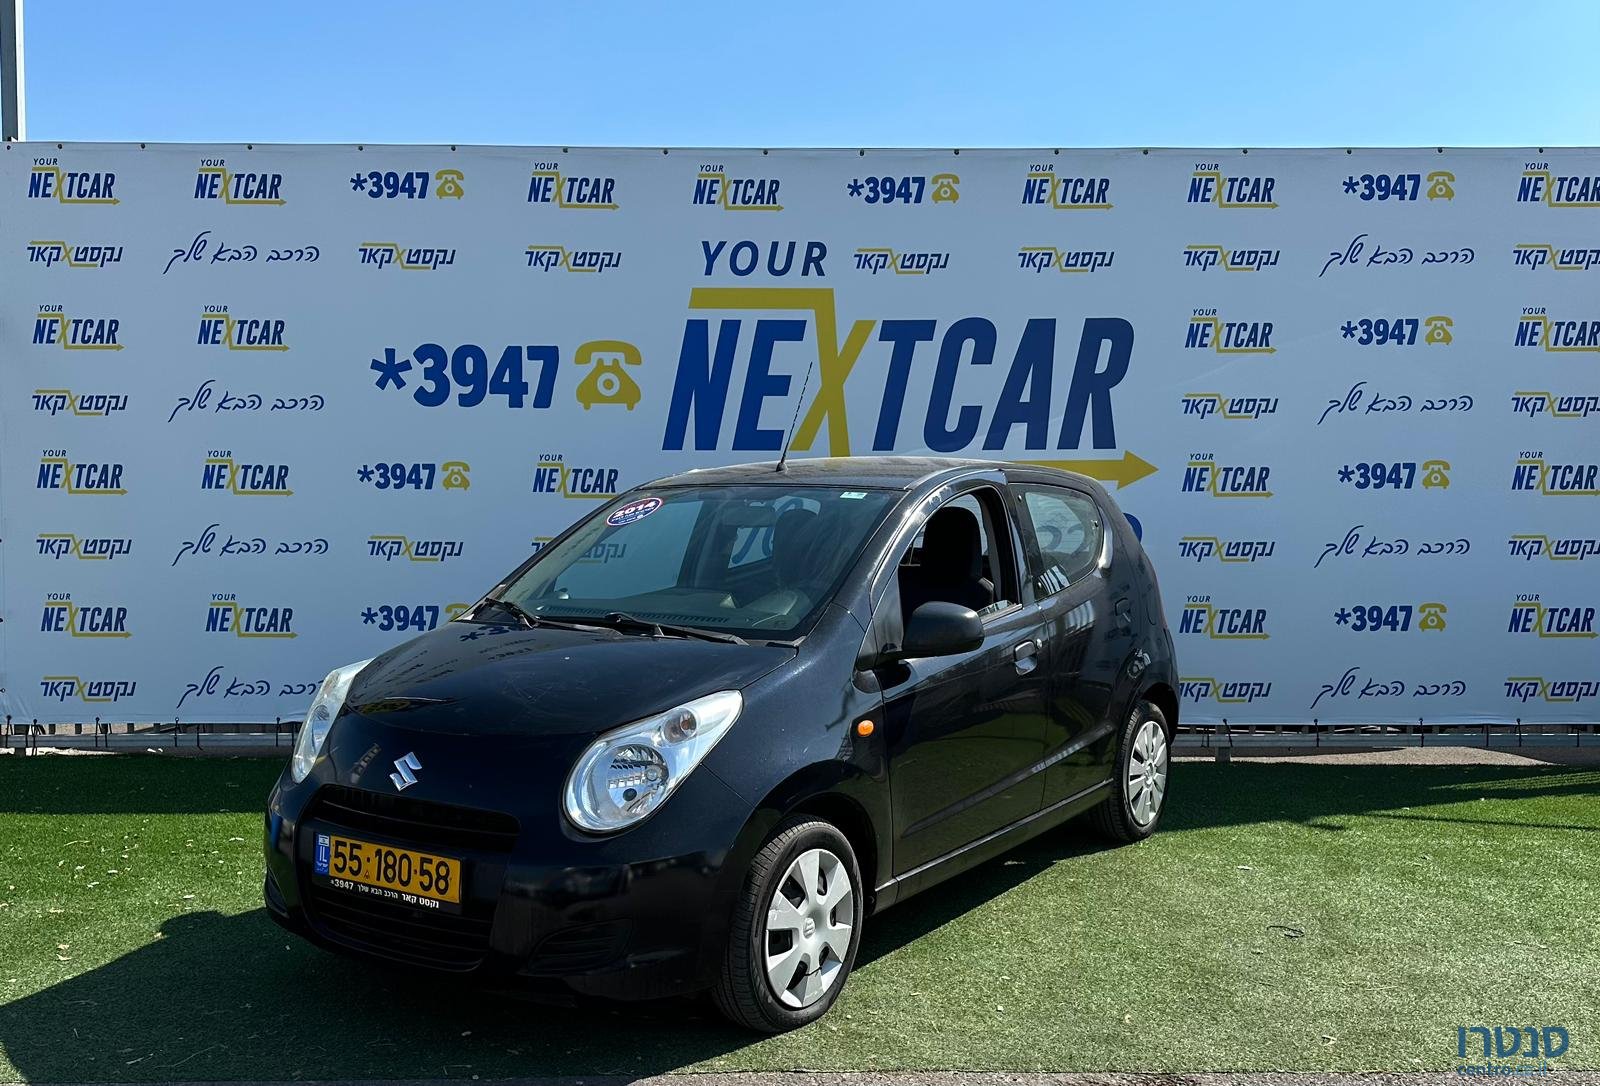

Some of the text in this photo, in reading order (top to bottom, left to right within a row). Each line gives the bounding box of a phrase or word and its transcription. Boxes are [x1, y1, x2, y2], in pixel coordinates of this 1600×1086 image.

[33, 157, 58, 166] YOUR
[200, 159, 225, 167] YOUR
[534, 162, 559, 171] YOUR
[699, 164, 724, 173] YOUR
[1029, 163, 1054, 172] YOUR
[1194, 163, 1219, 171] YOUR
[1524, 162, 1549, 171] YOUR
[28, 173, 115, 198] NEXTCAR
[194, 173, 282, 199] NEXTCAR
[528, 177, 615, 203] NEXTCAR
[693, 179, 780, 205] NEXTCAR
[1022, 178, 1109, 204] NEXTCAR
[1188, 177, 1275, 202] NEXTCAR
[163, 231, 319, 274] הרכב הבא שלך
[702, 241, 827, 276] YOUR
[1319, 234, 1474, 277] הרכב הבא שלך
[39, 304, 63, 313] YOUR
[203, 304, 228, 313] YOUR
[1192, 308, 1217, 317] YOUR
[1522, 307, 1546, 315] YOUR
[33, 319, 119, 344] NEXTCAR
[198, 320, 284, 345] NEXTCAR
[1185, 323, 1273, 348] NEXTCAR
[1515, 321, 1600, 346] NEXTCAR
[662, 317, 1135, 454] NEXTCAR
[168, 380, 324, 422] הרכב הבא שלך
[1318, 382, 1473, 425] הרכב הבא שלך
[42, 449, 67, 457] YOUR
[207, 450, 232, 458] YOUR
[539, 453, 563, 462] YOUR
[1189, 453, 1214, 461] YOUR
[1519, 451, 1544, 459] YOUR
[37, 464, 123, 488] NEXTCAR
[202, 465, 289, 489] NEXTCAR
[533, 468, 618, 493] NEXTCAR
[1182, 467, 1269, 492] NEXTCAR
[1512, 465, 1598, 490] NEXTCAR
[613, 501, 657, 519] 2014
[172, 524, 328, 566] הרכב הבא שלך
[1314, 525, 1470, 568] הרכב הבא שלך
[47, 592, 71, 601] YOUR
[211, 593, 236, 601] YOUR
[1186, 595, 1211, 603] YOUR
[1516, 593, 1540, 602] YOUR
[41, 607, 127, 632] NEXTCAR
[206, 608, 293, 632] NEXTCAR
[1179, 609, 1266, 633] NEXTCAR
[1508, 608, 1595, 632] NEXTCAR
[177, 666, 323, 708] רכב הבא שלך
[1310, 667, 1466, 709] הרכב הבא שלך
[319, 845, 328, 863] IL
[401, 893, 417, 904] קאר
[419, 897, 440, 909] נקסט
